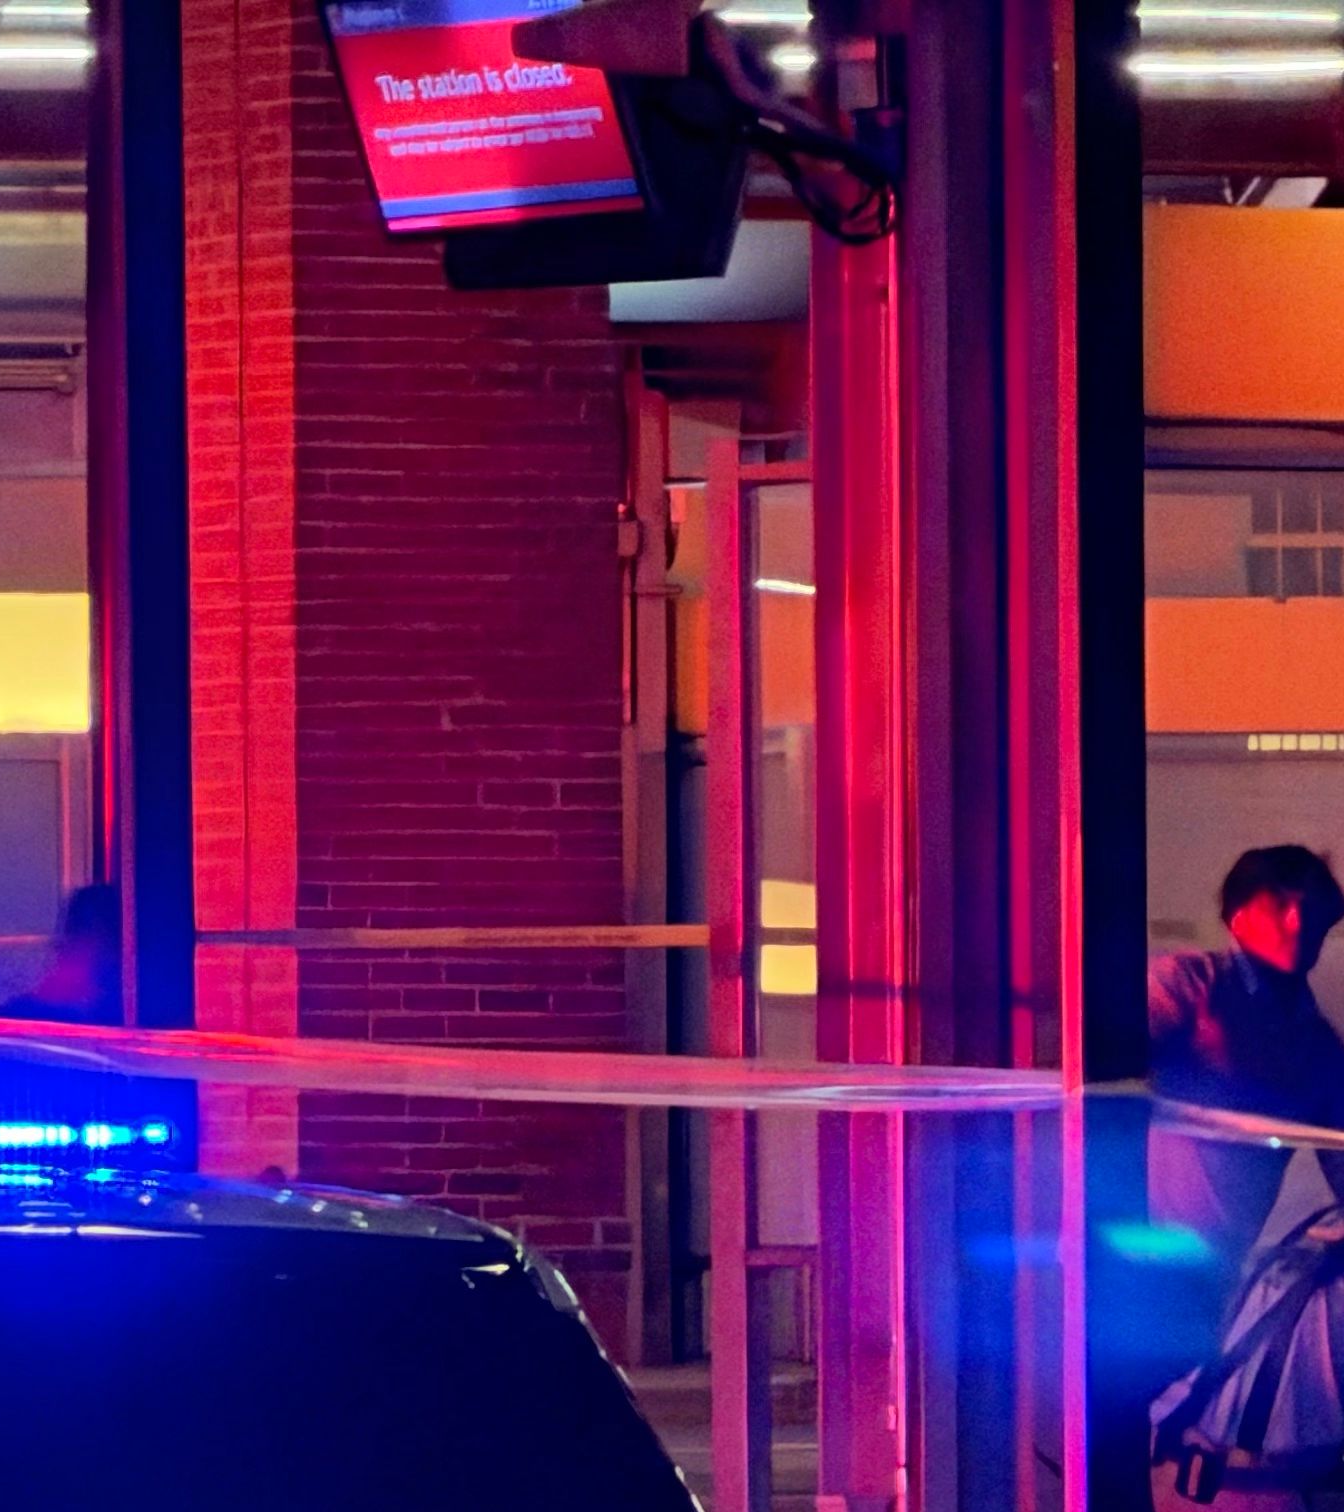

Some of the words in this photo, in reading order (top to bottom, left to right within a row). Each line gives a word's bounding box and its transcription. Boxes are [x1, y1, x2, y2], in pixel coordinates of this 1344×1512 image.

[376, 74, 415, 103] The
[419, 70, 483, 100] station
[485, 67, 504, 93] is
